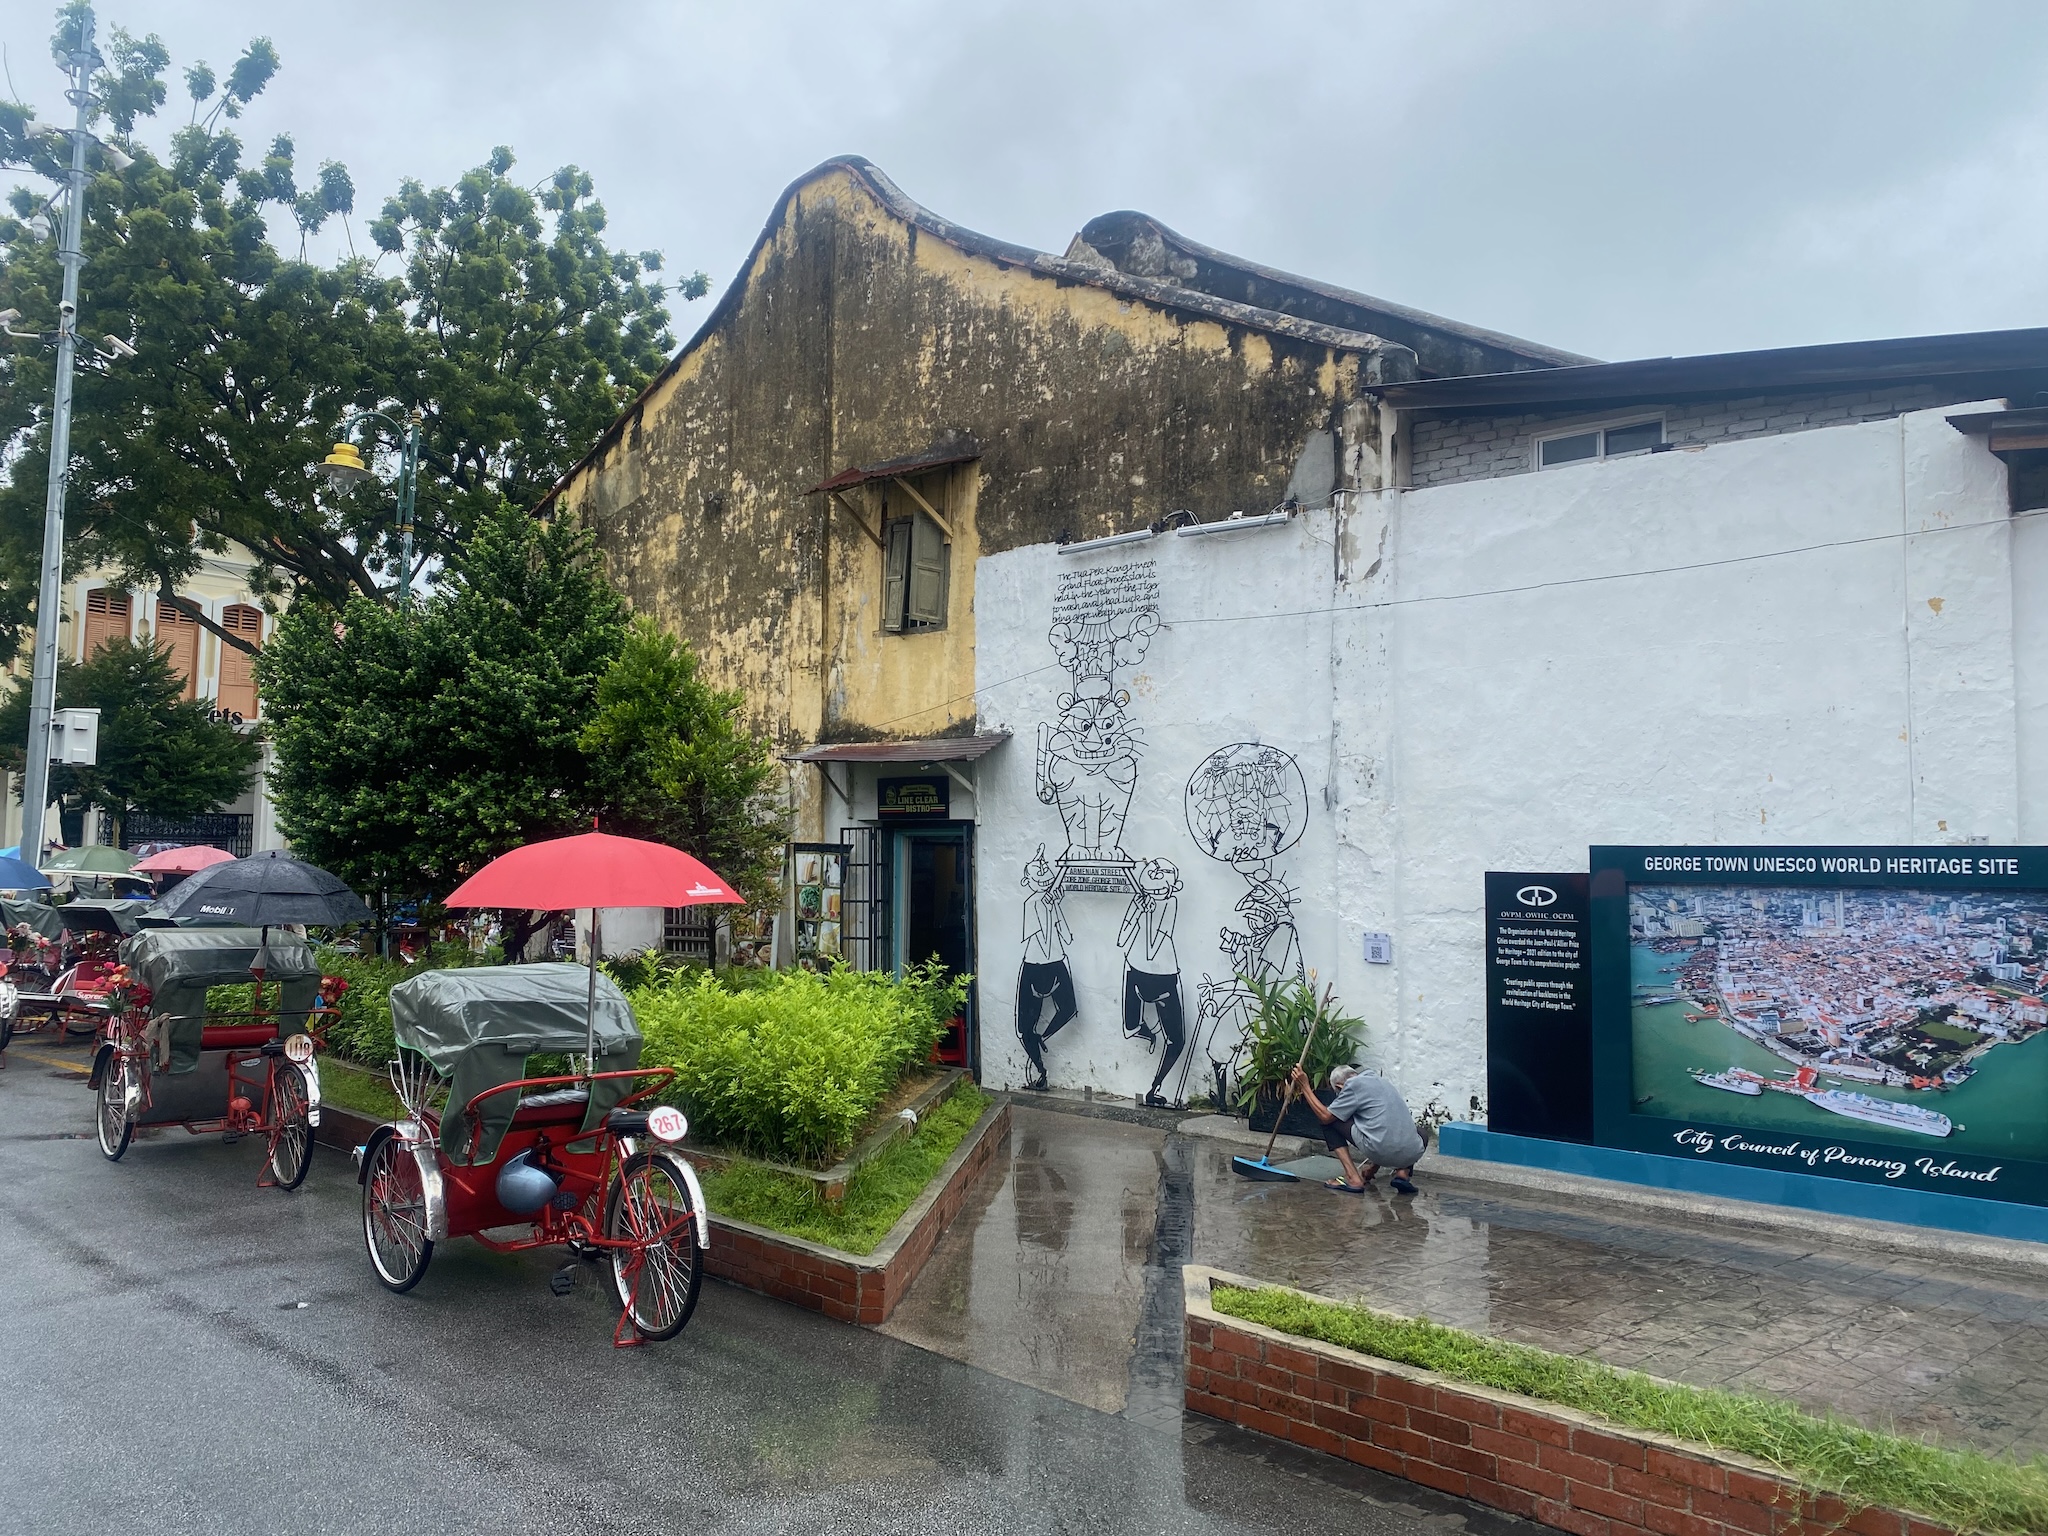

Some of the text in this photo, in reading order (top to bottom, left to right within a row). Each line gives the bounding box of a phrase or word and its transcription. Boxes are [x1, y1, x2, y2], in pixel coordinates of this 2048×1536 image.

[1057, 573, 1072, 582] The
[1107, 563, 1129, 575] Kong
[1058, 581, 1083, 593] Grand
[1084, 579, 1104, 588] Float
[1105, 571, 1146, 584] Procession
[1054, 593, 1070, 603] held
[1081, 590, 1094, 599] the
[1124, 582, 1137, 593] the
[1138, 580, 1160, 594] Tiger
[1061, 602, 1081, 611] wash
[1082, 599, 1104, 611] away
[1105, 597, 1120, 606] bad
[1122, 594, 1141, 603] luck
[1143, 589, 1160, 600] and
[1052, 600, 1160, 623] bring great wealth and health
[898, 795, 939, 804] LINE CLEAR
[905, 804, 931, 812] BISTRO
[1644, 857, 2019, 875] GEORGE TOWN UNESCO WORLD HERITAGE SITE
[1111, 877, 1127, 885] TOWN
[200, 905, 227, 914] Mobil
[1552, 912, 1574, 920] OCPM
[1558, 930, 1576, 939] Heritage
[1496, 937, 1508, 945] Cities
[1568, 940, 1580, 948] Prize
[1505, 948, 1522, 957] Heritage
[1526, 948, 1537, 956] 2021
[1537, 949, 1552, 957] edition
[1565, 950, 1573, 959] city
[1496, 957, 1510, 966] George
[1535, 960, 1564, 968] comprehensive
[1523, 979, 1535, 988] public
[1535, 981, 1549, 989] spaces
[1549, 981, 1566, 991] through
[1566, 981, 1574, 989] the
[77, 991, 104, 1000] Supre
[1538, 991, 1558, 999] backlanes
[1563, 992, 1571, 1000] the
[1501, 998, 1513, 1006] World
[1514, 998, 1531, 1009] Heritage
[1531, 1000, 1540, 1009] City
[1546, 1001, 1560, 1011] George
[654, 1114, 681, 1134] 267
[1673, 1128, 2004, 1183] City Council of Penang Island
